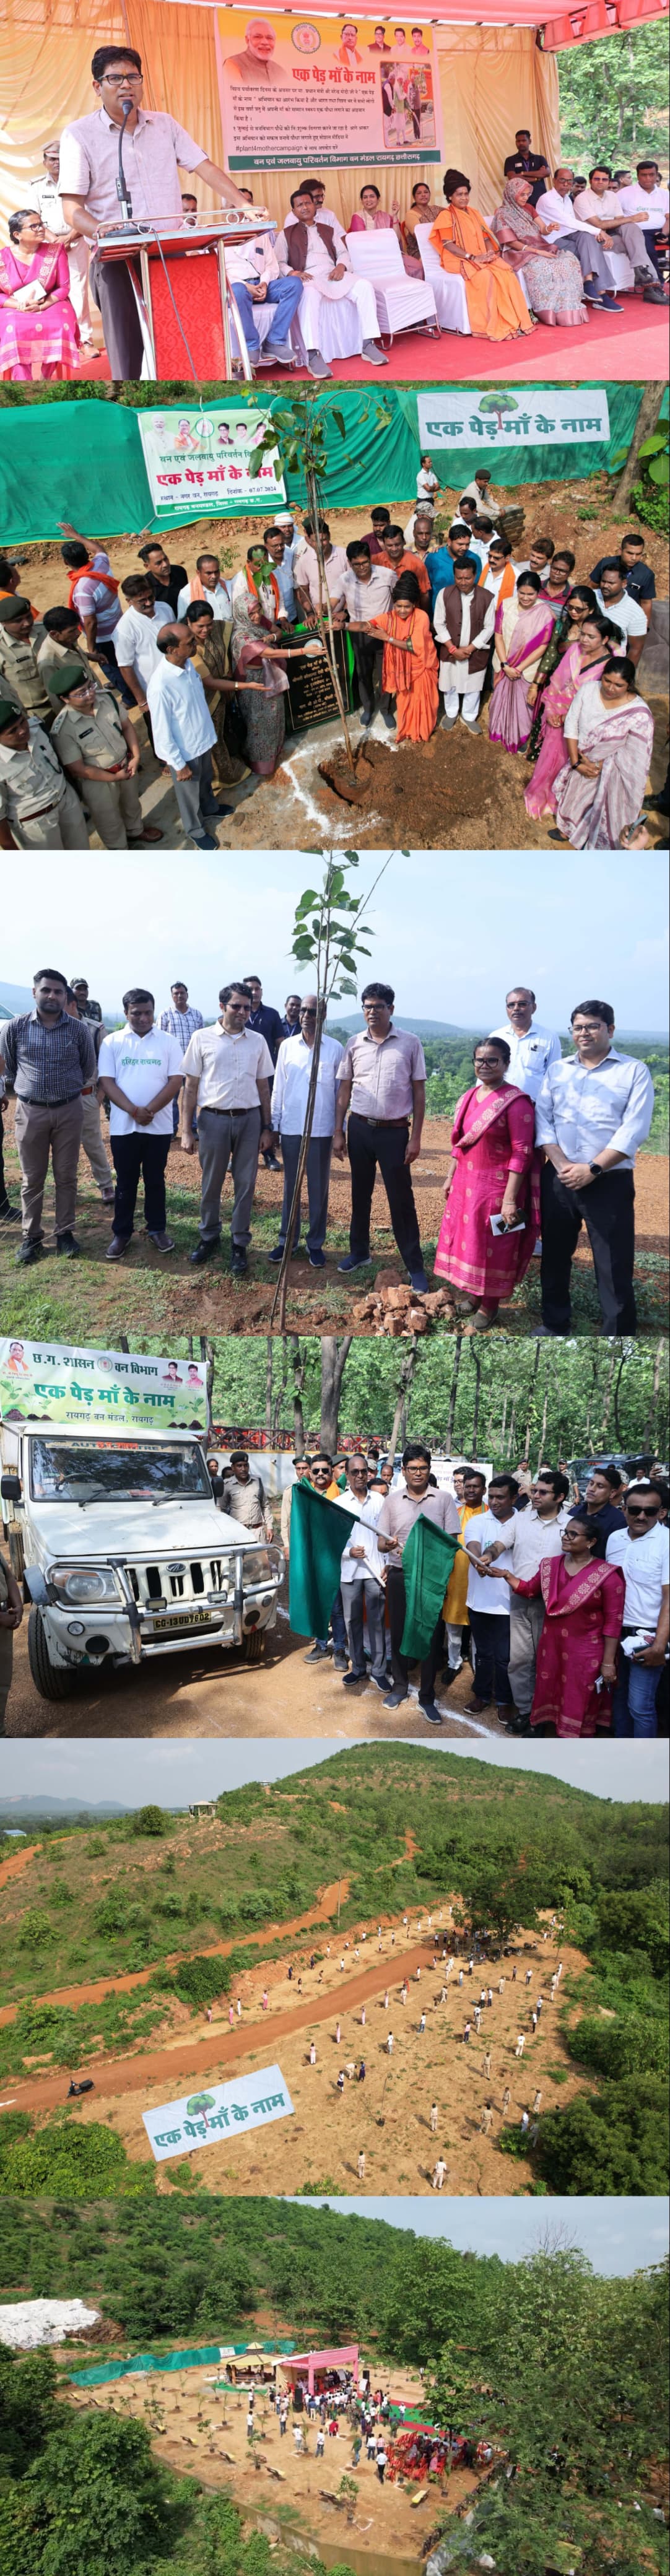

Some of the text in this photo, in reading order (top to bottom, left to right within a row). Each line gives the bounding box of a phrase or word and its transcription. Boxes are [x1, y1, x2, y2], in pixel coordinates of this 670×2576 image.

[292, 69, 310, 81] एक
[312, 66, 326, 85] पेड़
[343, 67, 354, 83] के
[355, 71, 375, 84] नाम
[235, 144, 303, 152] #plant4mothercampaign
[266, 157, 276, 165] एवं
[277, 158, 302, 166] जलवायु
[303, 155, 328, 163] परिवर्तन
[329, 155, 347, 163] विभाग
[425, 412, 602, 440] एक पेड़ माँ के नाम
[175, 453, 186, 463] एवं
[188, 453, 214, 462] जलवायु
[217, 449, 243, 459] परिवर्तन
[156, 473, 182, 486] एक
[185, 468, 204, 487] पेड़
[207, 464, 227, 481] माँ
[228, 465, 243, 480] के
[63, 1357, 94, 1369] शासन
[115, 1362, 129, 1373] वन
[131, 1362, 159, 1376] विभाग
[33, 1384, 66, 1399] एक
[70, 1382, 94, 1406] पेड़
[98, 1384, 121, 1404] माँ
[123, 1386, 139, 1404] के
[143, 1393, 175, 1408] नाम
[154, 2092, 285, 2147] एक पेड़ माँ के नाम
